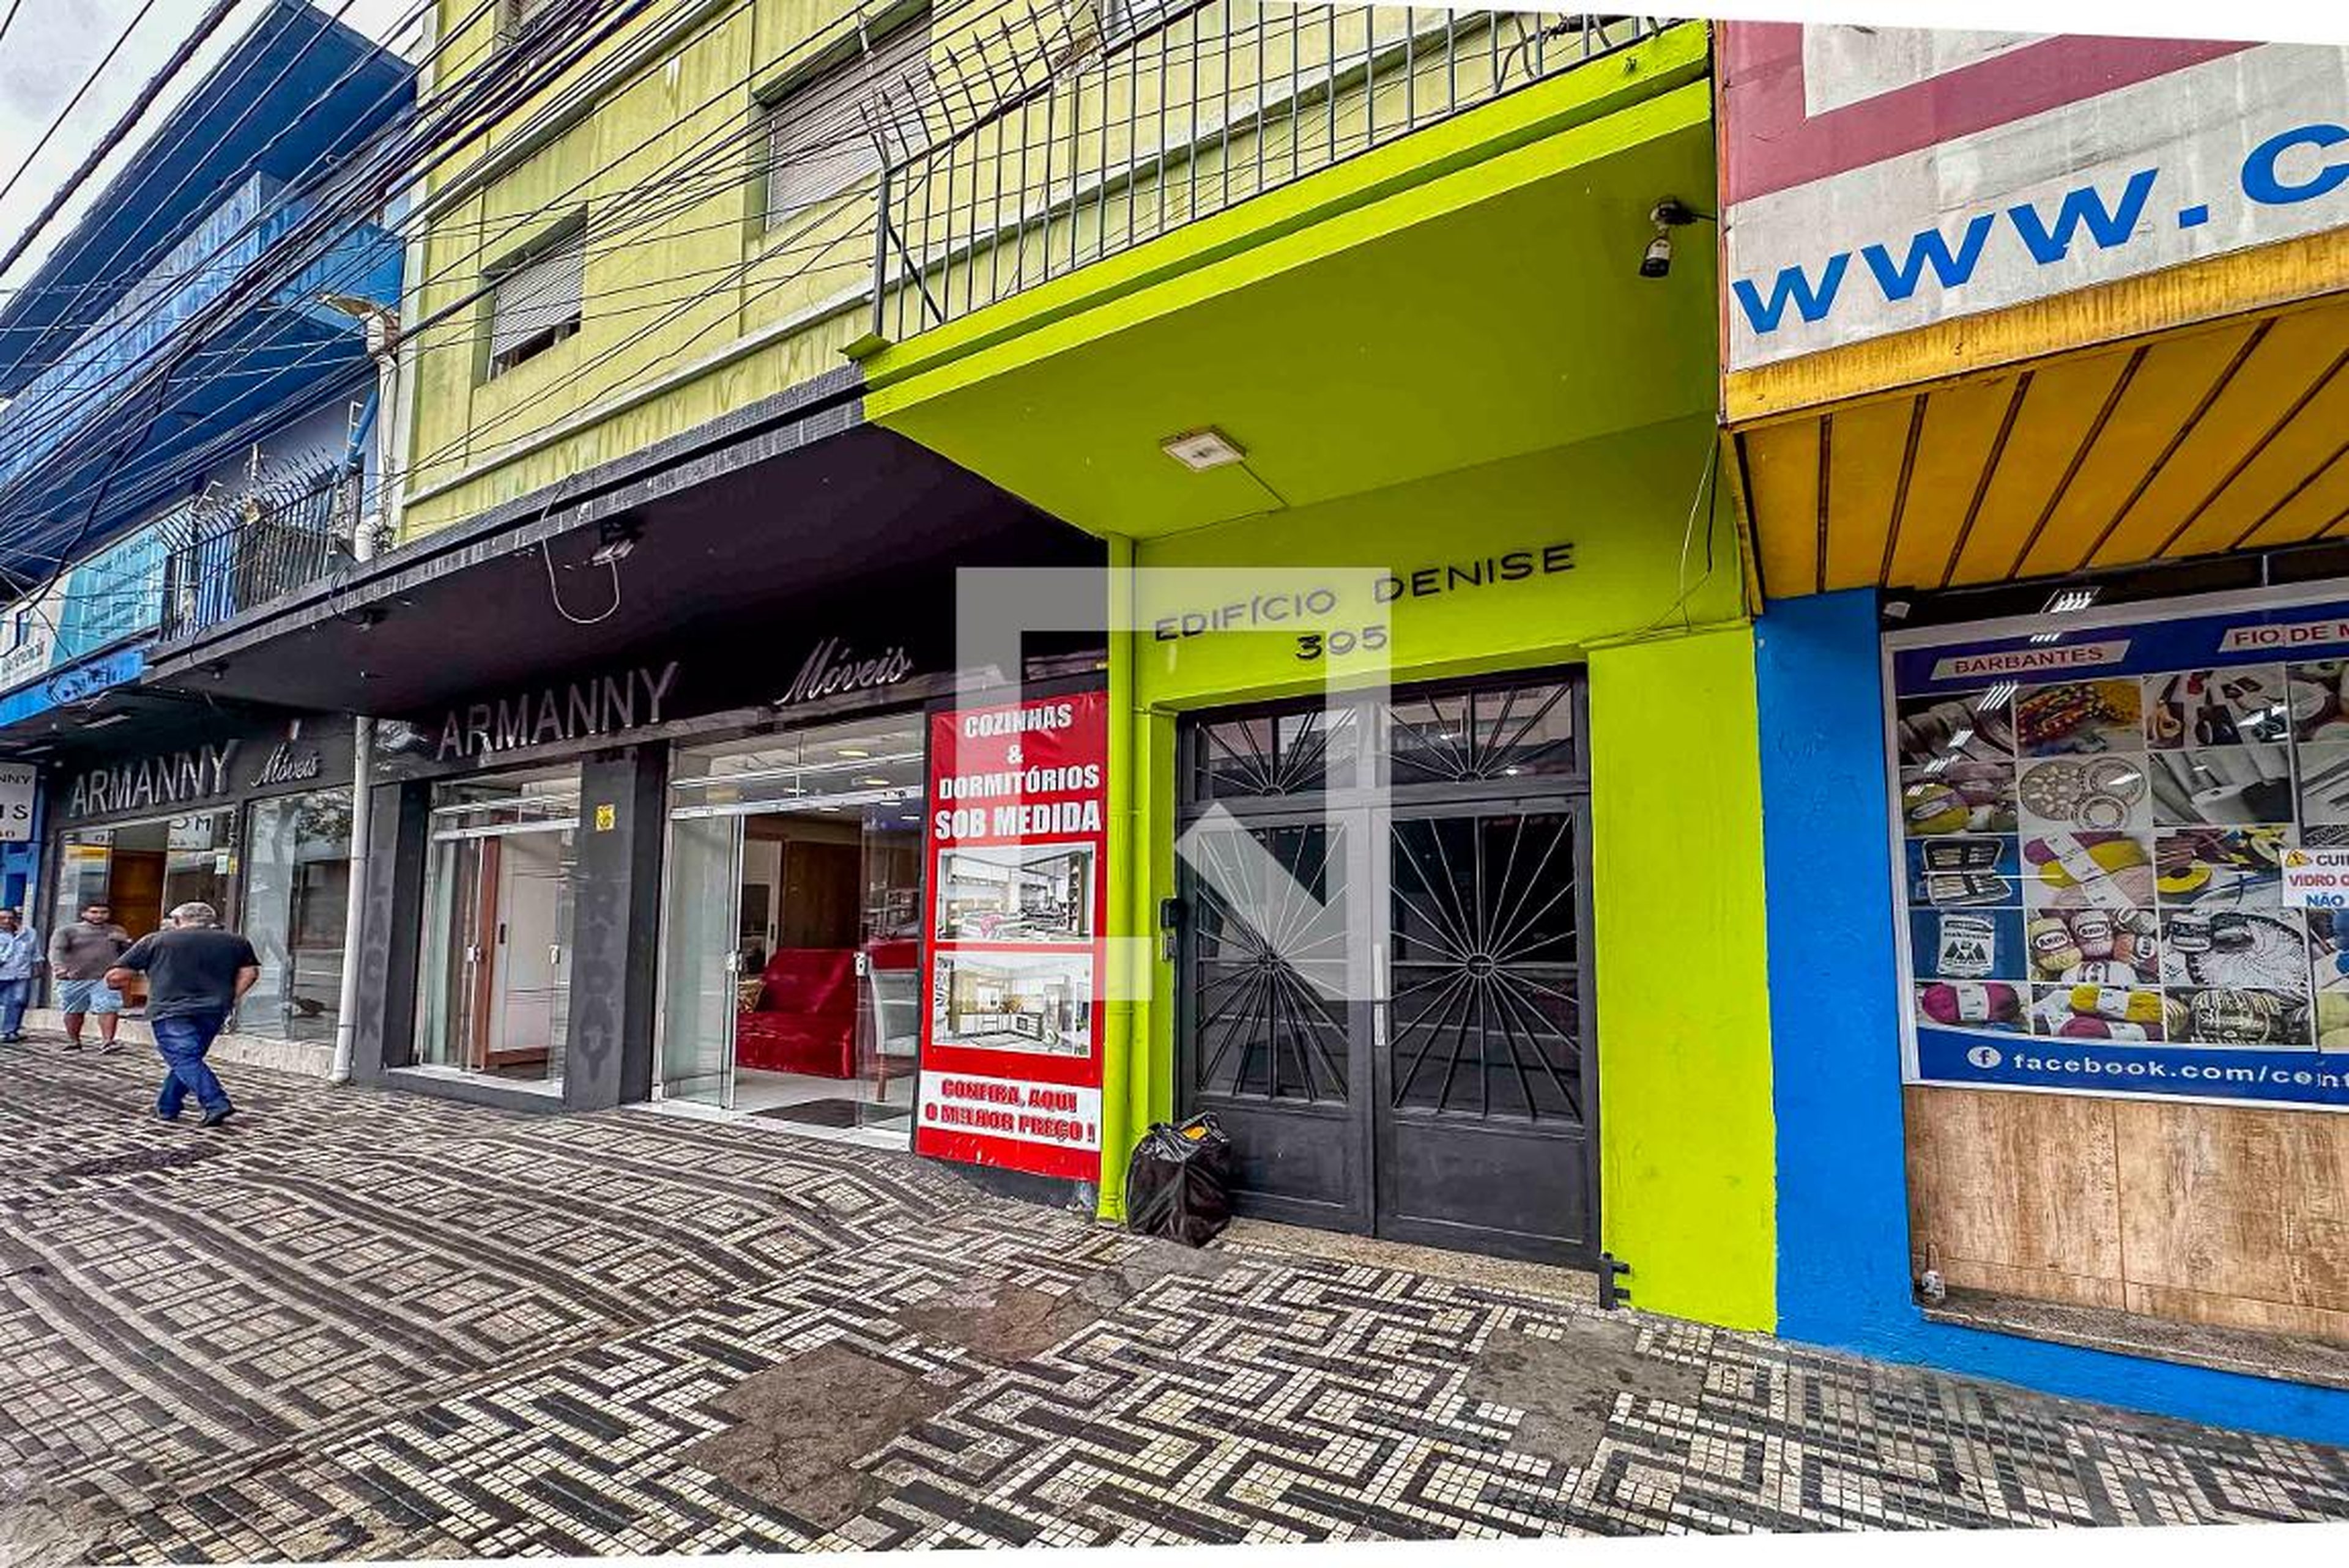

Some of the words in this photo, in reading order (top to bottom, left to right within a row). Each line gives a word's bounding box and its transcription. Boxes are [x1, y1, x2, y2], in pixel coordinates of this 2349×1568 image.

[1155, 588, 1337, 642] EDIFÍCIO
[1373, 543, 1575, 604] DENISE
[1296, 625, 1387, 660] 395
[2234, 629, 2280, 646] FIO
[2290, 625, 2329, 642] DE
[1954, 646, 2104, 674] BARBANTES
[435, 660, 679, 762] ARMANNY
[773, 636, 915, 705] Móveis
[964, 703, 1073, 738] COZINHAS
[1006, 744, 1024, 764] &
[69, 738, 239, 818] ARMANNY
[938, 764, 1100, 800] DORMITÓRIOS
[934, 808, 986, 840] SOB
[993, 800, 1102, 837] MEDIDA
[2288, 874, 2336, 887] VIDRO
[2306, 892, 2345, 907] NÃO
[1028, 1088, 1078, 1113] AQUI
[925, 1103, 938, 1121] O
[941, 1104, 1014, 1131] MELHOR
[1018, 1115, 1083, 1143] PREÇO
